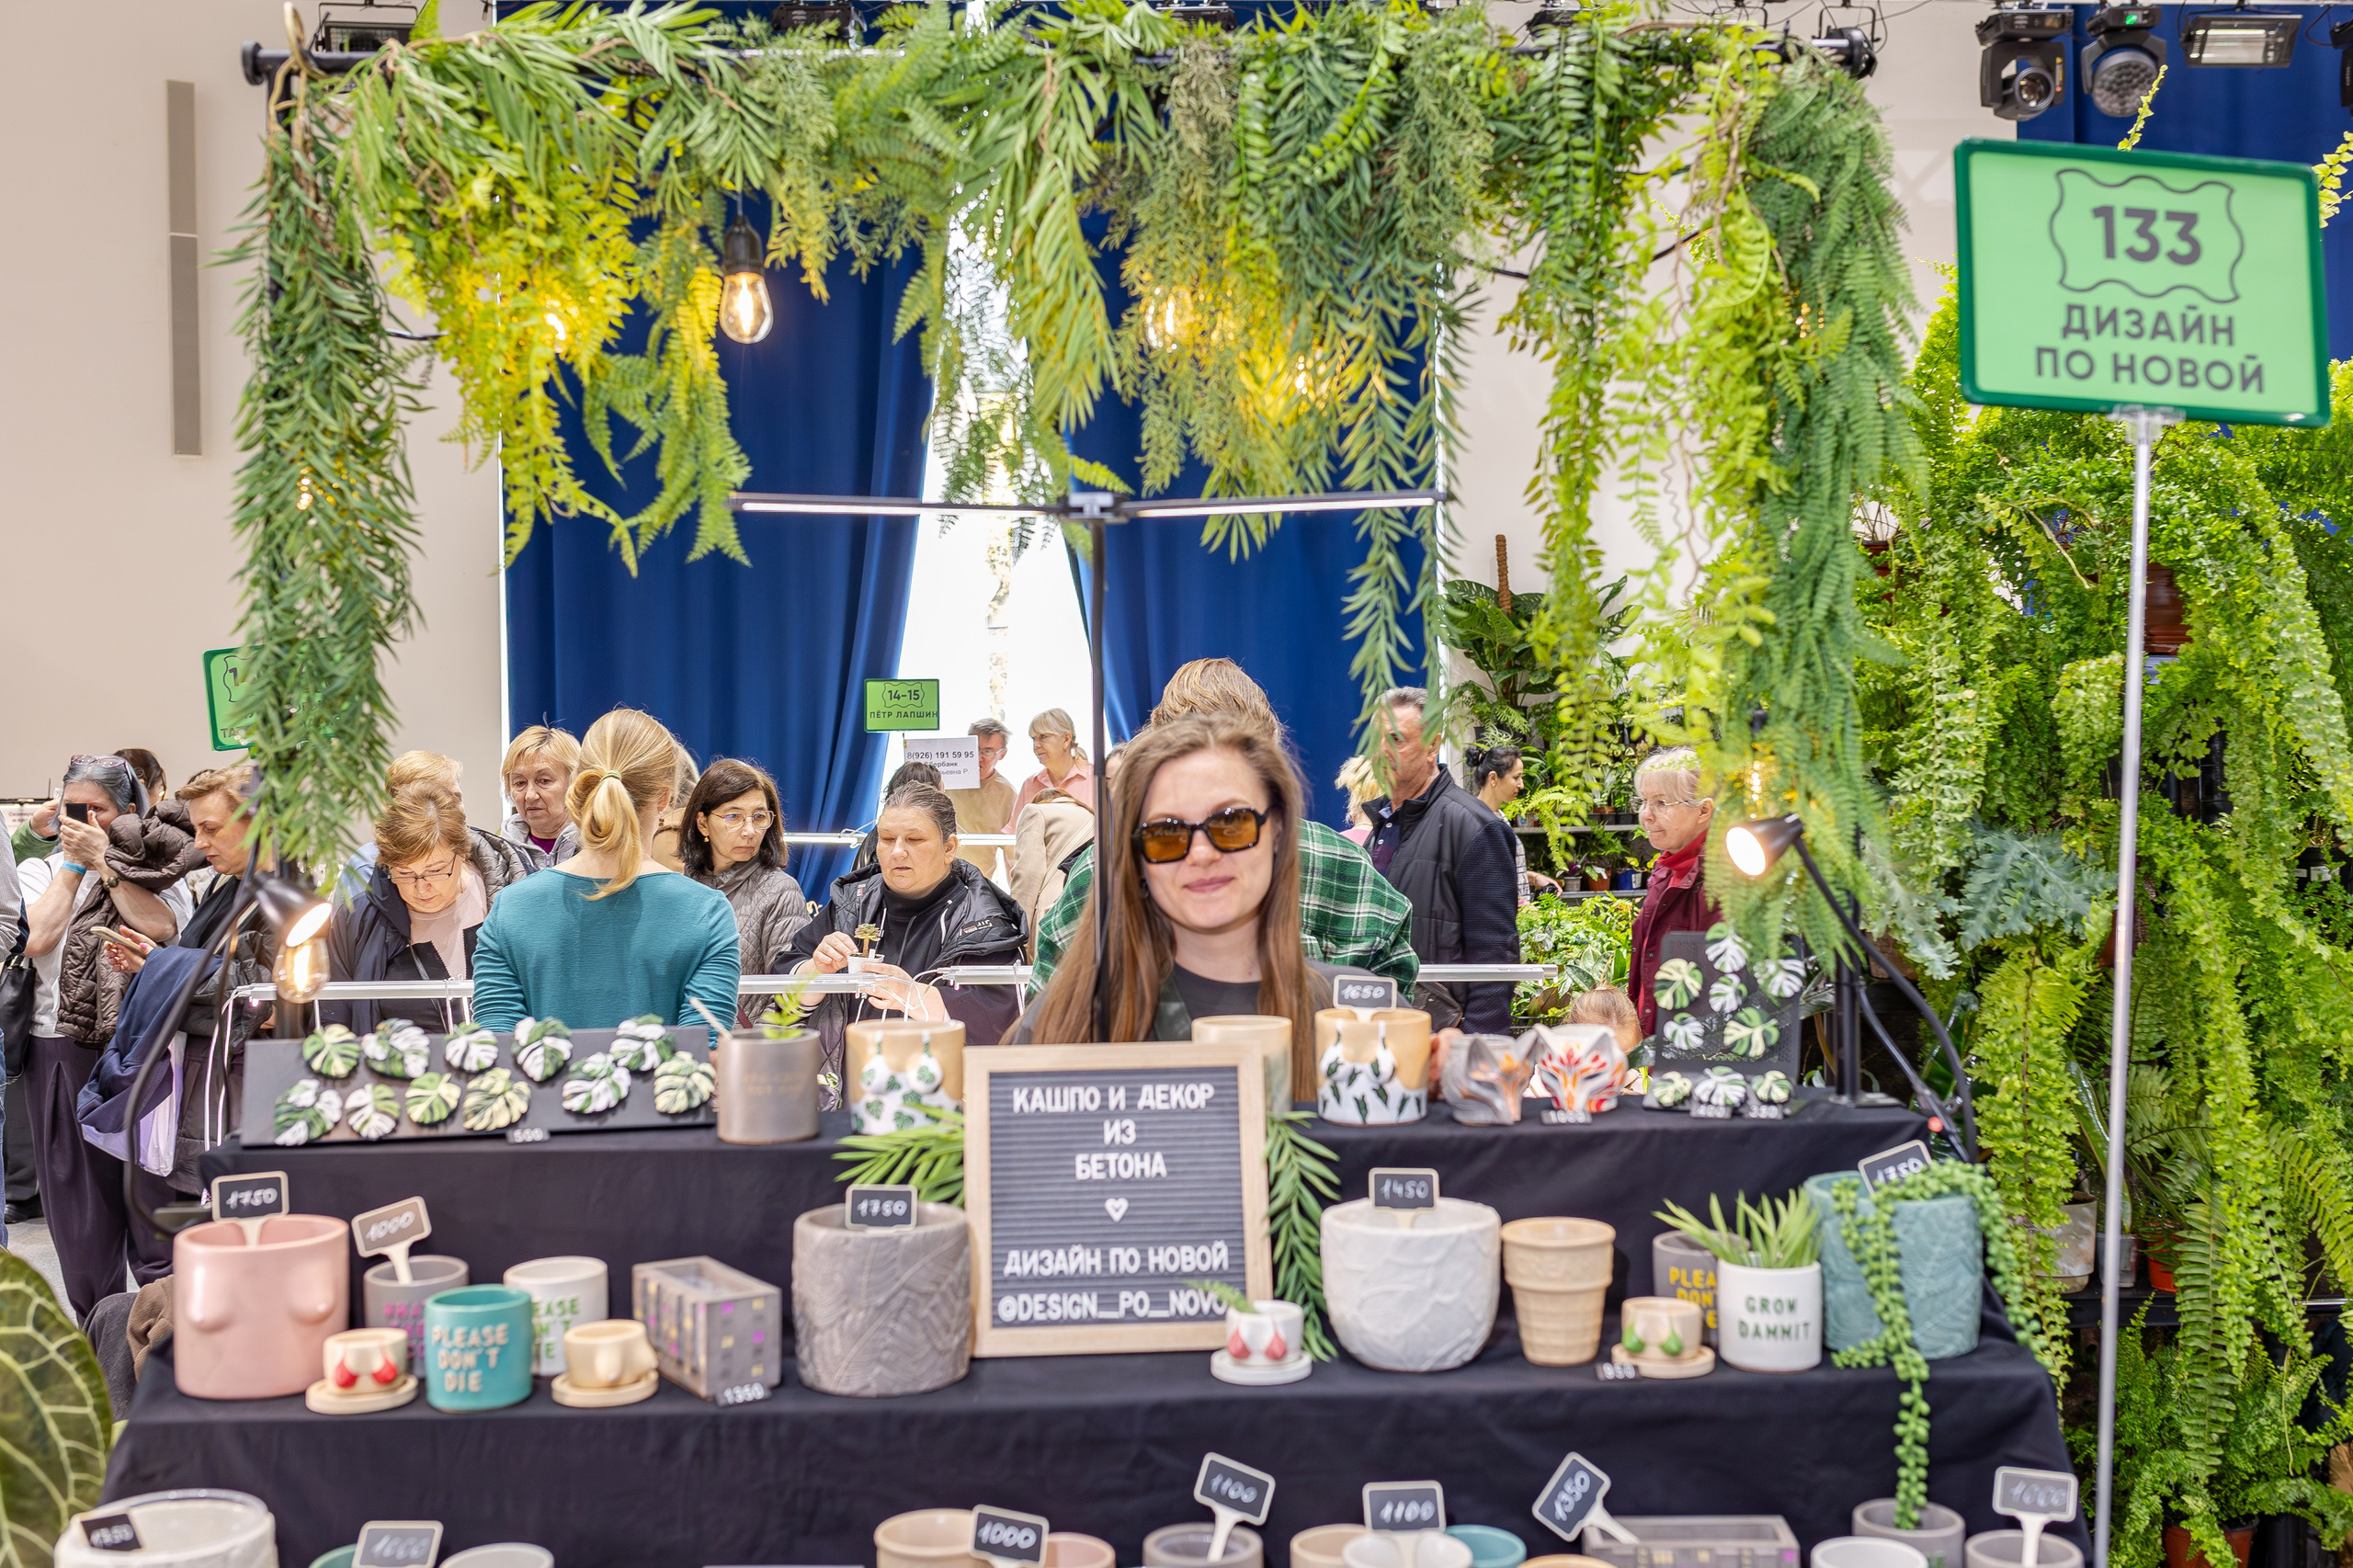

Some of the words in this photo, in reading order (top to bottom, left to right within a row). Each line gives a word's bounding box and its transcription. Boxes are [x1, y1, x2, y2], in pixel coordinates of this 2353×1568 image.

[2092, 205, 2202, 266] 133
[2063, 303, 2235, 347] ДИЗАЙН
[2035, 347, 2097, 381] ПО
[2113, 353, 2265, 394] НОВОЙ
[887, 689, 920, 701] 14-15
[869, 709, 893, 719] ПЁТР
[895, 710, 938, 719] ЛАПШИН
[906, 751, 933, 760] 8(926)
[935, 751, 949, 759] 191
[951, 751, 962, 759] 59
[963, 750, 974, 758] 95
[1341, 983, 1386, 1000] 1650
[1012, 1085, 1102, 1114] КАШПО
[1108, 1085, 1127, 1112] И
[1136, 1082, 1216, 1110] ДЕКОР
[1103, 1119, 1137, 1145] ИЗ
[1074, 1151, 1168, 1181] БЕТОНА
[226, 1187, 278, 1210] 1750
[1380, 1177, 1429, 1200] 1450
[857, 1199, 908, 1218] 1750
[1003, 1244, 1103, 1278] ДИЗАЙН
[1108, 1246, 1142, 1275] ПО
[1147, 1239, 1230, 1273] НОВОЙ
[1668, 1266, 1718, 1289] PLEA
[1745, 1295, 1798, 1315] GROW
[431, 1323, 510, 1349] PLEASE
[438, 1347, 502, 1371] DON'T
[444, 1369, 483, 1393] DIE
[1210, 1473, 1257, 1503] 1100
[1380, 1500, 1435, 1524] 1100
[977, 1520, 1037, 1549] 1000
